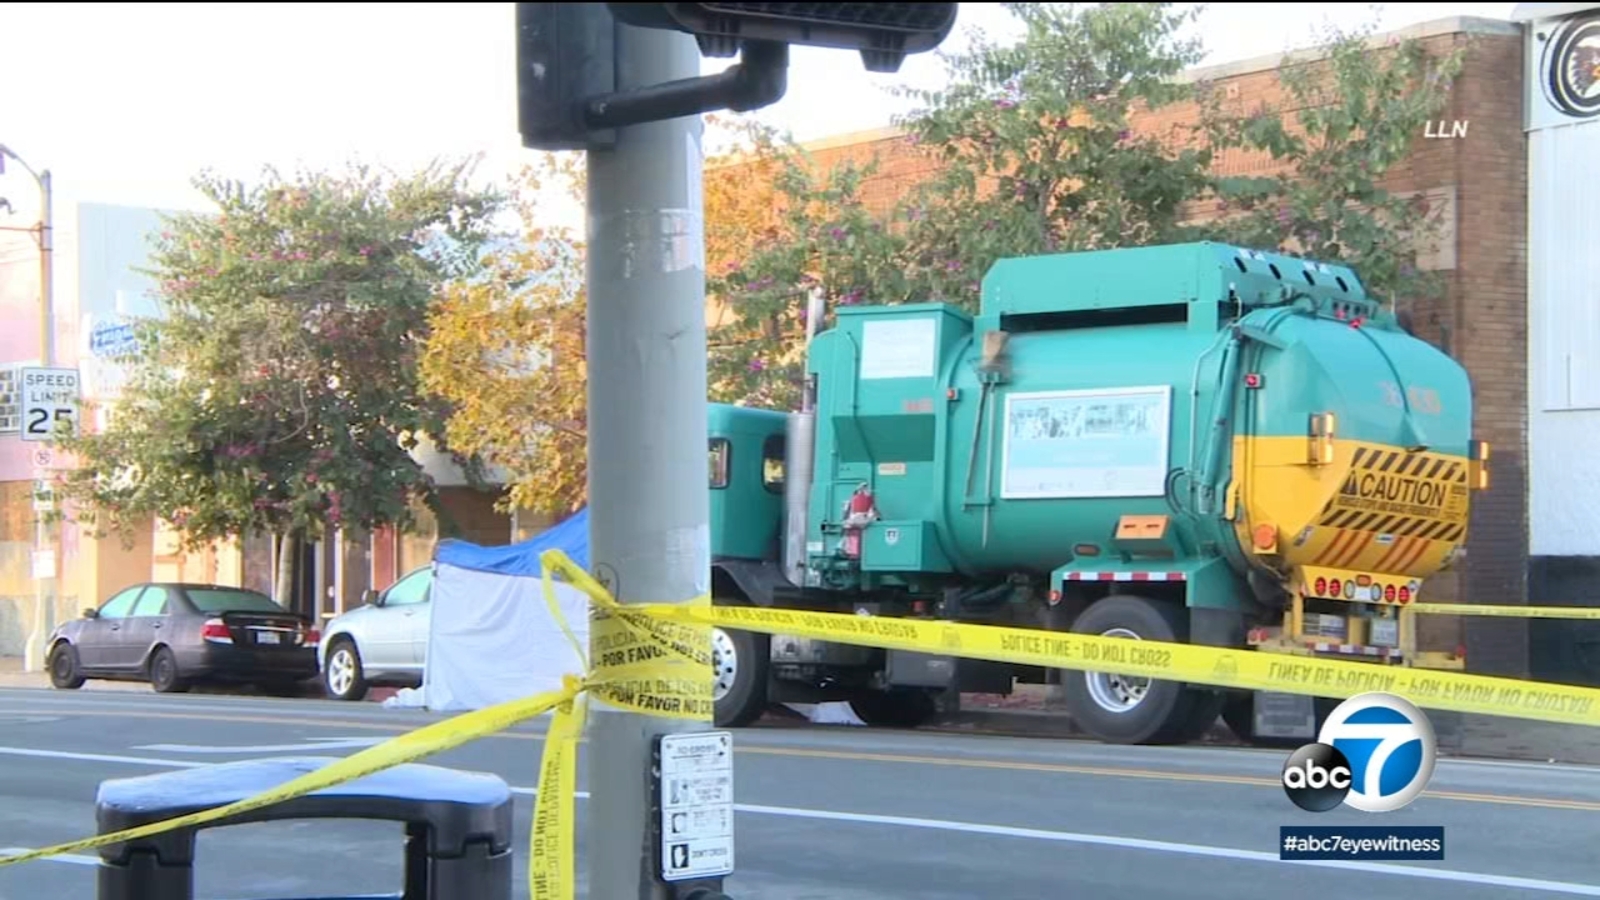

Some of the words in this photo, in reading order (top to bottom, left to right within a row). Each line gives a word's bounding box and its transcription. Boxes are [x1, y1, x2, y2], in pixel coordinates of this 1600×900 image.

[26, 374, 76, 387] SPEED
[31, 390, 70, 402] LIMIT
[28, 407, 73, 434] 25
[1359, 473, 1447, 506] CAUTION
[602, 650, 626, 667] POR
[628, 644, 667, 663] FAVO
[637, 694, 681, 712] FAVOR
[684, 700, 698, 714] NO
